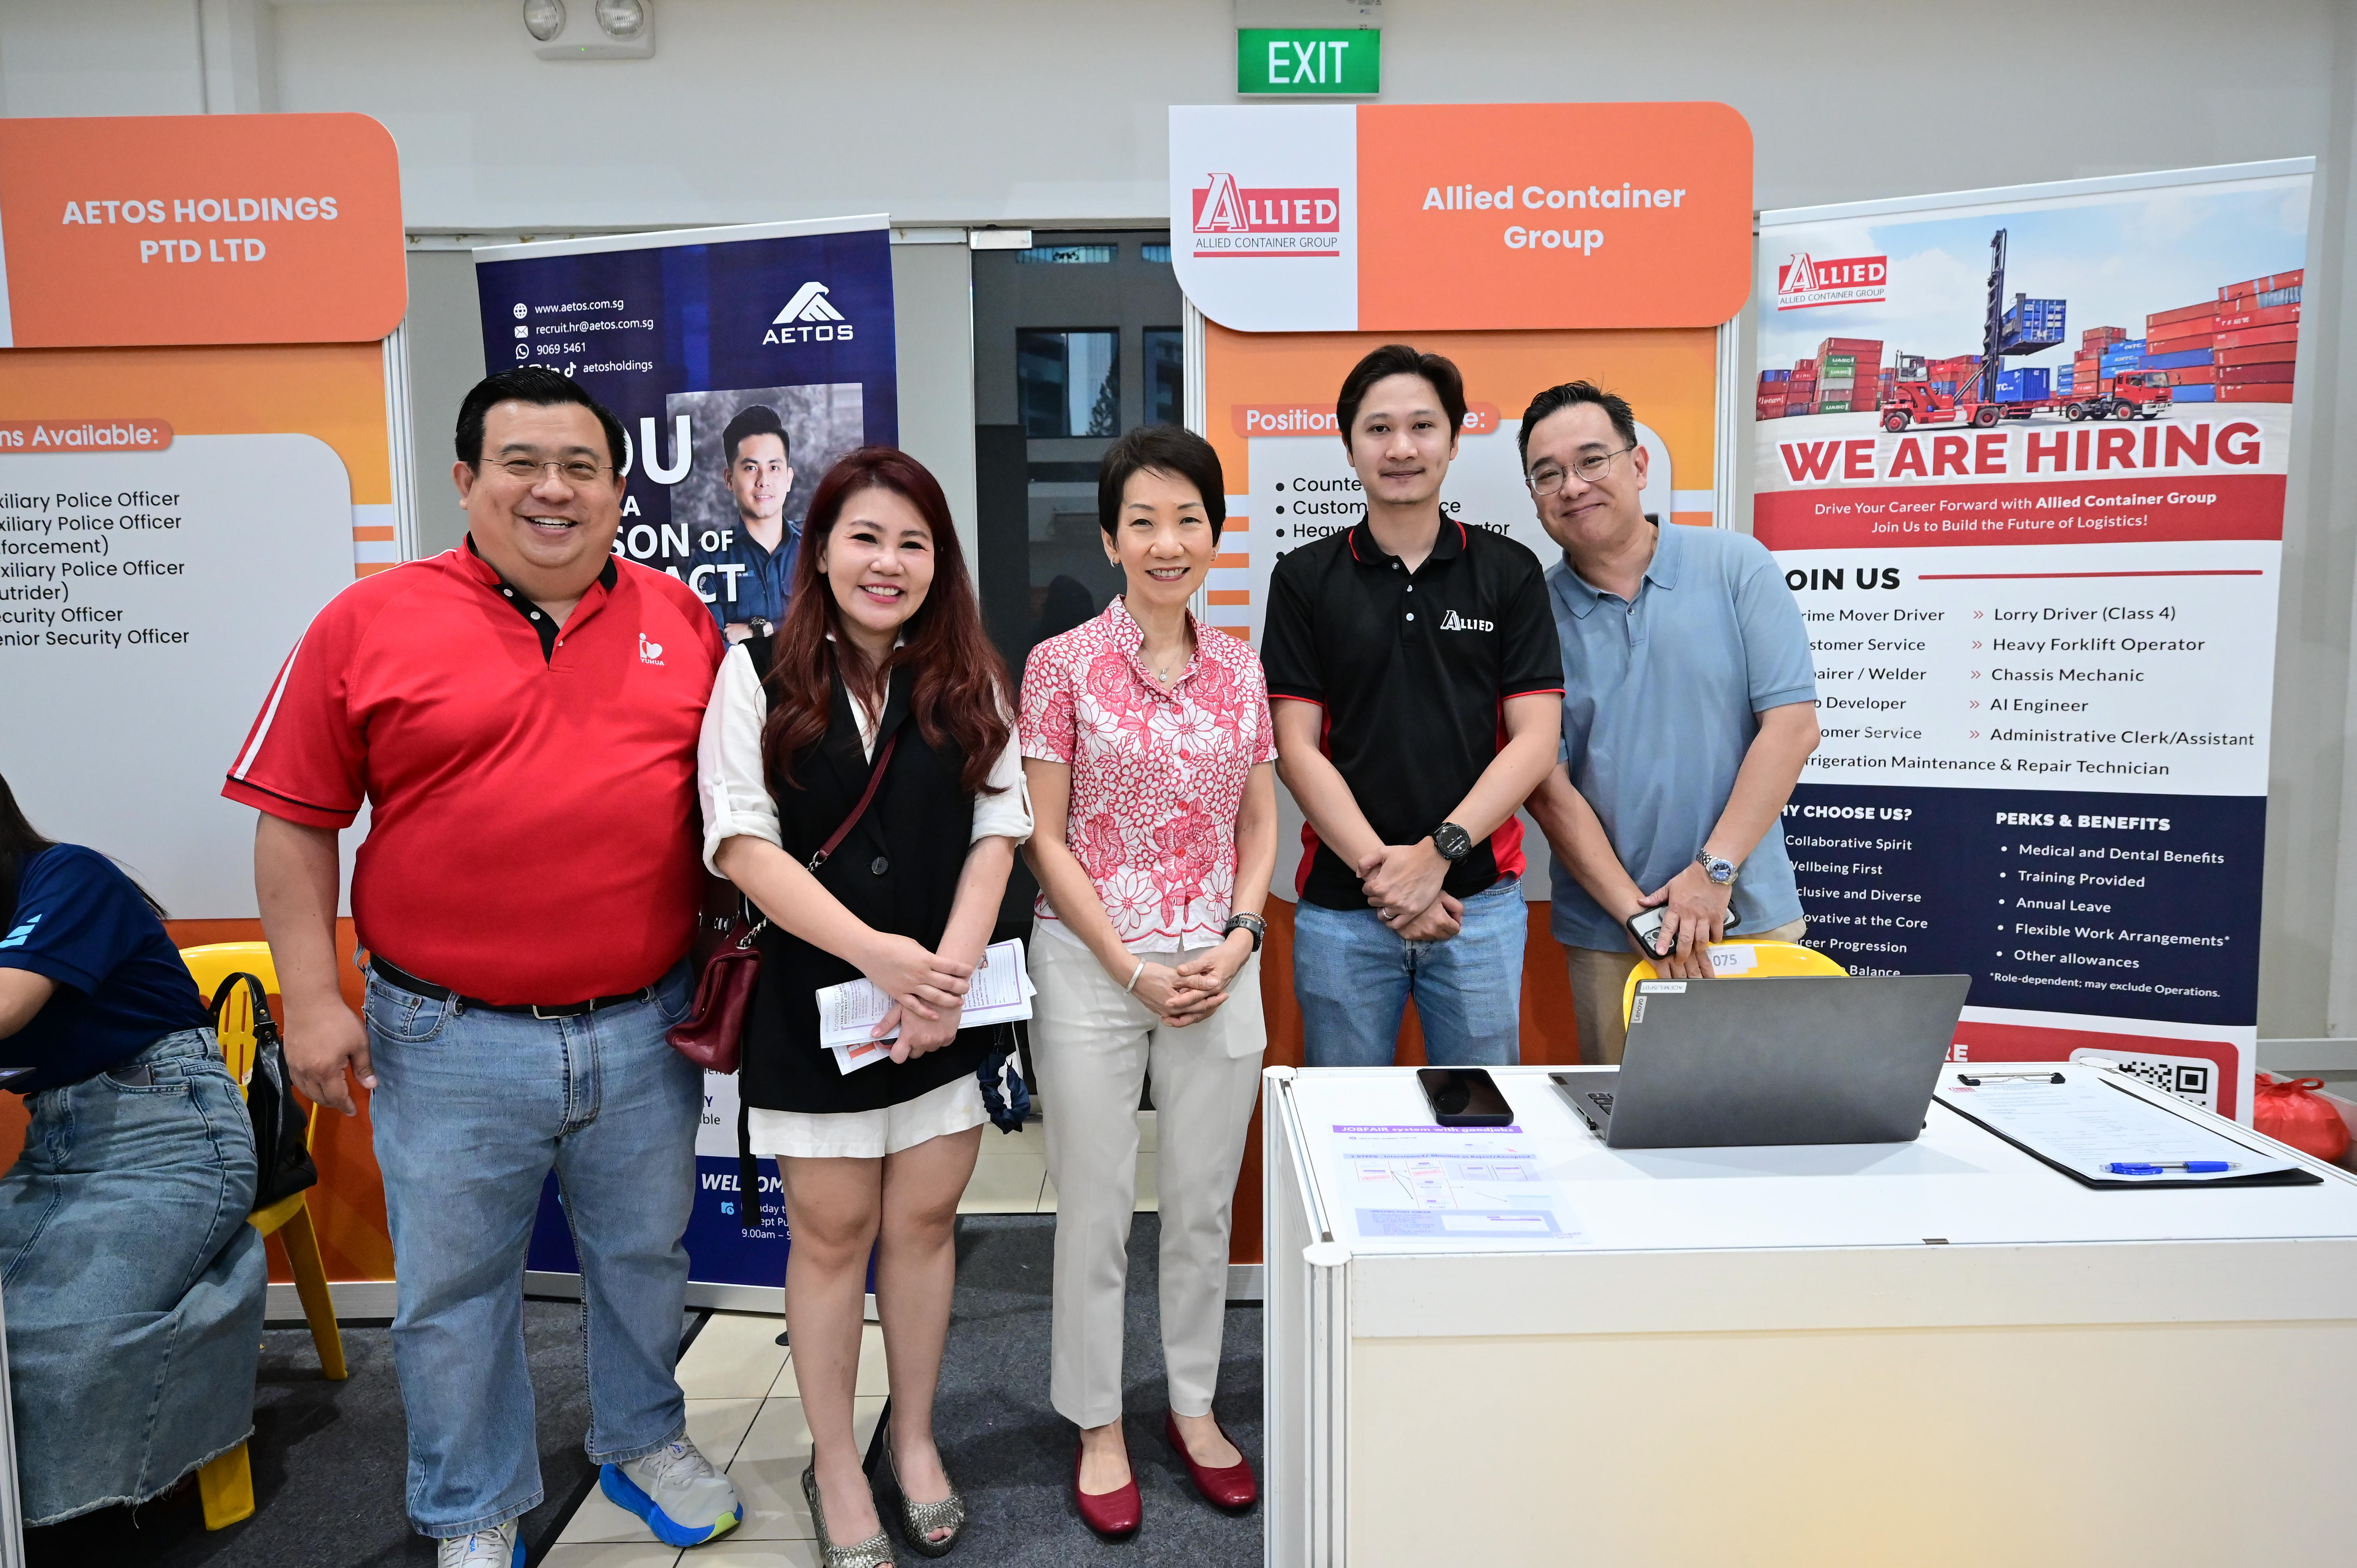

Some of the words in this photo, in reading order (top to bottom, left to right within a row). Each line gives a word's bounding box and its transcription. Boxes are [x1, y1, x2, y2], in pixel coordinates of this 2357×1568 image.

[1269, 41, 1348, 83] EXIT
[1195, 173, 1338, 232] ALLIED
[1422, 184, 1514, 210] Allied
[1522, 183, 1685, 209] Container
[62, 200, 166, 224] AETOS
[174, 197, 337, 222] HOLDINGS
[1196, 238, 1230, 247] ALLIED
[1235, 238, 1295, 247] CONTAINER
[1300, 238, 1337, 247] GROUP
[1504, 226, 1604, 256] Group
[140, 240, 201, 263] PTD
[210, 238, 266, 262] LTD
[1779, 253, 1885, 294] ALLIED
[1780, 295, 1805, 304] ALLIED
[1808, 291, 1853, 301] CONTAINER
[1856, 288, 1884, 297] GROUP
[535, 300, 624, 313] www.aetos.com.sg
[537, 320, 653, 334] recruit.hr@aetos.com.sg
[763, 325, 853, 345] AETOS
[537, 344, 560, 355] 9069
[564, 342, 585, 353] 5461
[583, 360, 652, 373] aetosholdings
[1247, 410, 1340, 430] Position
[32, 424, 158, 446] Available:
[1780, 440, 1875, 481] WE
[1889, 434, 2007, 477] ARE
[2027, 422, 2260, 472] HIRING
[1293, 478, 1362, 491] Counte
[0, 493, 50, 512] xiliary
[57, 492, 111, 507] Police
[118, 491, 179, 506] Officer
[1293, 501, 1368, 514] Custom
[1816, 503, 1851, 514] Drive
[1855, 503, 1885, 513] Your
[1889, 502, 1935, 512] Career
[1940, 499, 1997, 511] Forward
[2002, 498, 2032, 509] with
[2036, 496, 2080, 508] Allied
[2085, 494, 2163, 507] Container
[2167, 492, 2216, 505] Group
[0, 517, 51, 535] xiliary
[59, 515, 113, 530] Police
[120, 514, 181, 529] Officer
[1294, 524, 1345, 538] Heav
[1872, 522, 1898, 532] Join
[1903, 521, 1920, 532] Us
[1924, 522, 1938, 531] to
[1943, 519, 1977, 531] Build
[1982, 519, 2004, 530] the
[2008, 519, 2055, 529] Future
[2059, 517, 2073, 528] of
[2078, 515, 2147, 530] Logistics!
[0, 535, 108, 556] forcement)
[610, 523, 689, 559] SON
[701, 530, 733, 552] OF
[1, 562, 55, 581] xiliary
[62, 561, 117, 576] Police
[124, 560, 184, 575] Officer
[1785, 569, 1844, 591] OIN
[1857, 568, 1899, 589] US
[0, 581, 68, 602] utrider)
[0, 609, 55, 627] curity
[62, 607, 122, 622] Officer
[1440, 610, 1493, 632] ALLIED
[1840, 610, 1889, 621] Mover
[1894, 609, 1944, 620] Driver
[1995, 609, 2038, 622] Lorry
[2044, 608, 2097, 620] Driver
[2103, 607, 2153, 622] (Class
[2159, 606, 2175, 621] 4)
[0, 632, 40, 646] enior
[46, 630, 121, 648] Security
[128, 629, 189, 643] Officer
[1810, 639, 1864, 650] stomer
[1868, 639, 1925, 650] Service
[1994, 639, 2045, 653] Heavy
[2051, 639, 2115, 650] Forklift
[2122, 639, 2204, 653] Operator
[1814, 668, 1854, 680] airer
[1858, 668, 1864, 680] /
[1869, 668, 1926, 680] Welder
[1992, 669, 2053, 680] Chassis
[2060, 669, 2143, 681] Mechanic
[1827, 697, 1906, 711] Developer
[1991, 699, 2007, 710] AI
[2014, 699, 2088, 713] Engineer
[1821, 729, 1860, 738] omer
[1865, 727, 1921, 738] Service
[1991, 729, 2115, 742] Administrative
[2122, 731, 2254, 745] Clerk/Assistant
[1806, 754, 1887, 769] frigeration
[1892, 757, 1995, 770] Maintenance
[2001, 759, 2011, 770] &
[2018, 759, 2071, 773] Repair
[2077, 761, 2168, 774] Technician
[1781, 805, 1800, 816] HY
[1804, 806, 1875, 819] CHOOSE
[1880, 808, 1912, 820] US?
[1997, 812, 2054, 826] PERKS
[2059, 814, 2073, 827] &
[2078, 815, 2170, 831] BENEFITS
[1786, 835, 1872, 849] Collaborative
[1876, 839, 1912, 851] Spirit
[2020, 844, 2074, 856] Medical
[2079, 848, 2104, 858] and
[2110, 848, 2159, 861] Dental
[2164, 851, 2224, 863] Benefits
[1853, 863, 1882, 874] First
[2018, 871, 2075, 885] Training
[2080, 874, 2145, 887] Provided
[1797, 886, 1840, 898] clusive
[1844, 889, 1866, 899] and
[1871, 890, 1921, 902] Diverse
[2016, 898, 2065, 910] Annual
[2071, 900, 2111, 913] Leave
[1804, 913, 1850, 924] ovative
[1855, 916, 1867, 925] at
[1871, 916, 1892, 926] the
[1896, 917, 1928, 928] Core
[2016, 923, 2070, 936] Flexible
[2075, 927, 2114, 939] Work
[1800, 939, 1826, 948] reer
[1830, 939, 1906, 952] Progression
[1713, 954, 1737, 966] 075
[2014, 950, 2056, 962] Other
[2060, 953, 2139, 968] allowances
[834, 991, 839, 1000] my
[2085, 982, 2107, 990] may
[2110, 983, 2152, 992] exclude
[2155, 985, 2220, 997] Operations.
[1633, 998, 1643, 1022] Lenovo
[702, 1173, 783, 1193] WELOM
[742, 1229, 775, 1239] 9.00am
